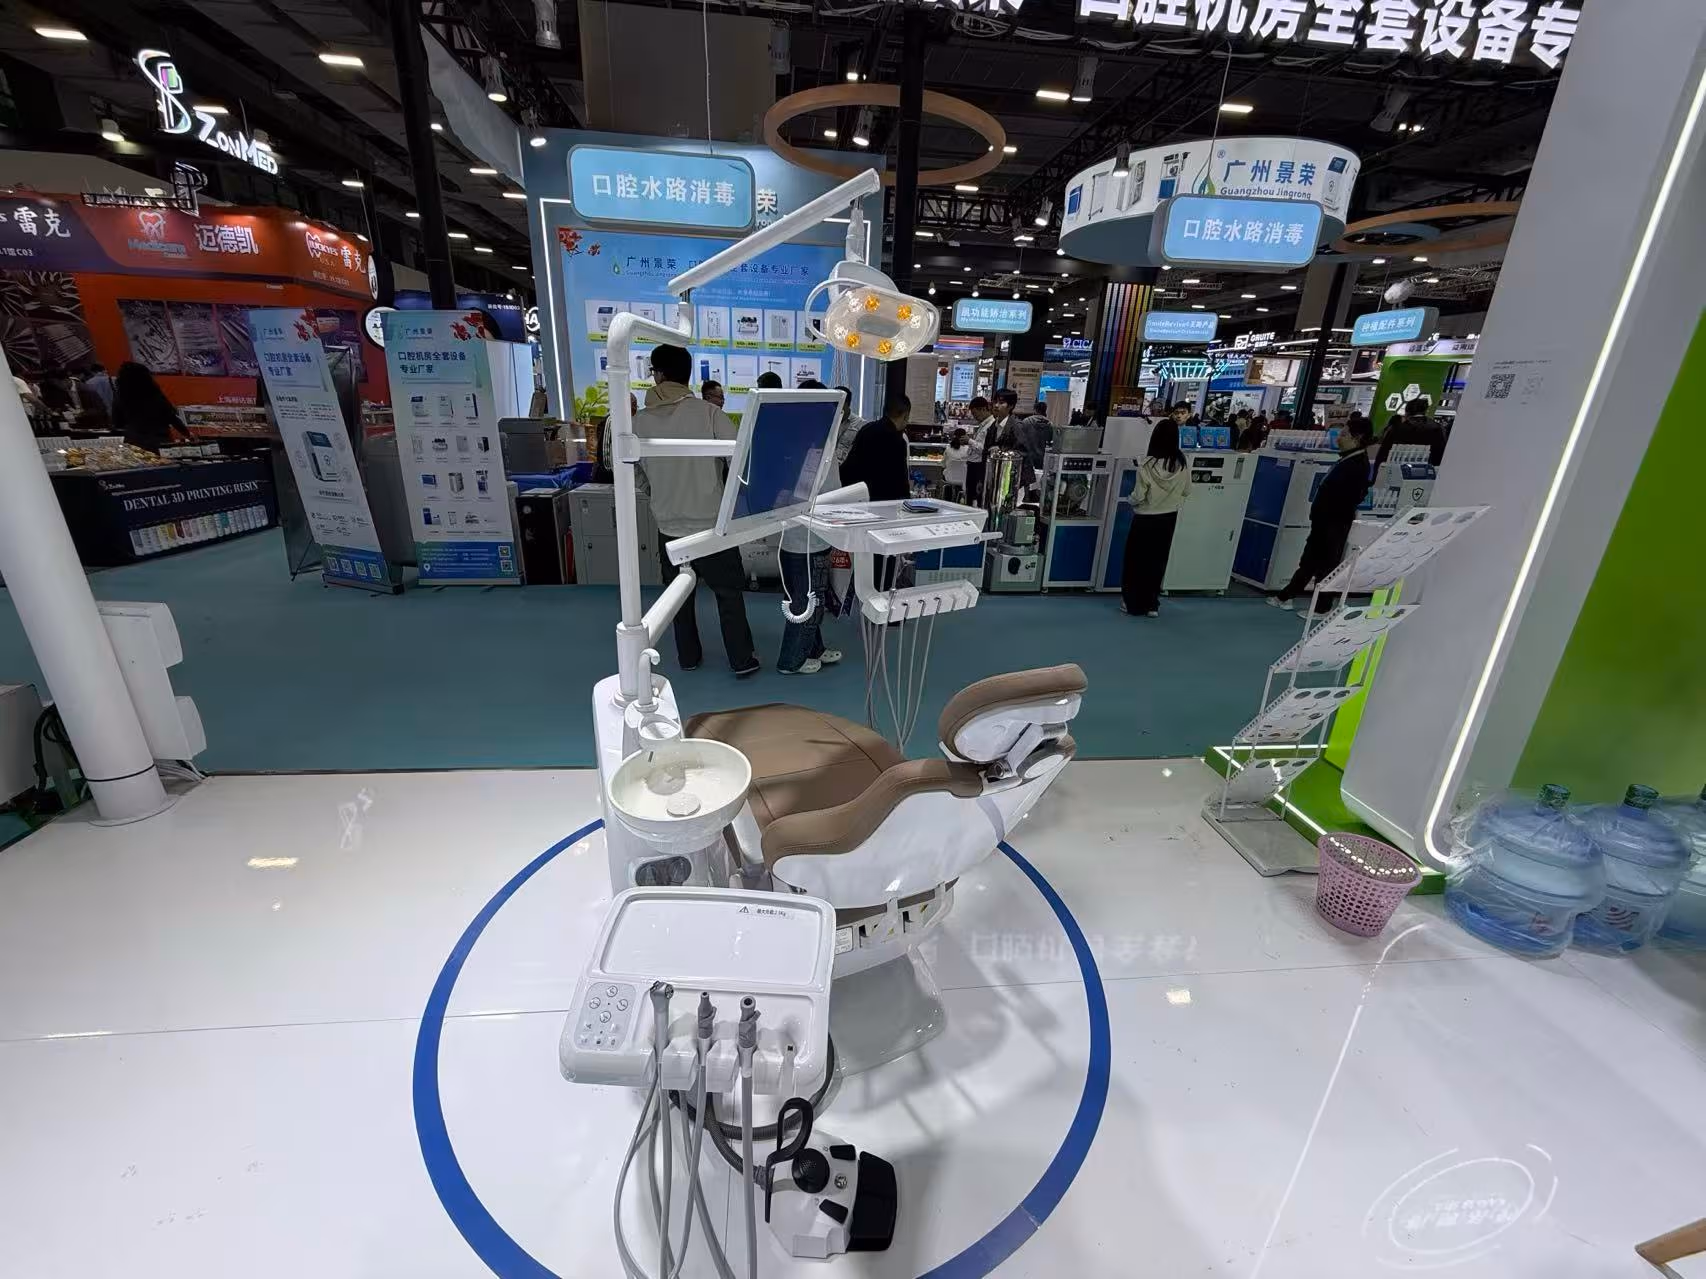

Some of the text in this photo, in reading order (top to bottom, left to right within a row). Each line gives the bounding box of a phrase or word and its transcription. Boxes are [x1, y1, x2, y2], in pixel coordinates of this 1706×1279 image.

[1223, 160, 1316, 186] 广州景荣
[591, 173, 736, 207] 口腔水路消毒
[1220, 186, 1275, 197] Guangzhou
[13, 206, 71, 237] 雷克
[1183, 219, 1304, 246] 口腔水路消毒
[194, 224, 259, 254] 迈德凯
[341, 245, 366, 273] 雷克
[626, 256, 678, 270] 广州景荣
[398, 351, 467, 361] 口腔机房全套设备
[400, 364, 434, 374] 专业厂家
[123, 495, 171, 511] DENTAL
[172, 492, 185, 504] 3D
[186, 484, 233, 501] PRINTING
[233, 480, 259, 493] RESIN
